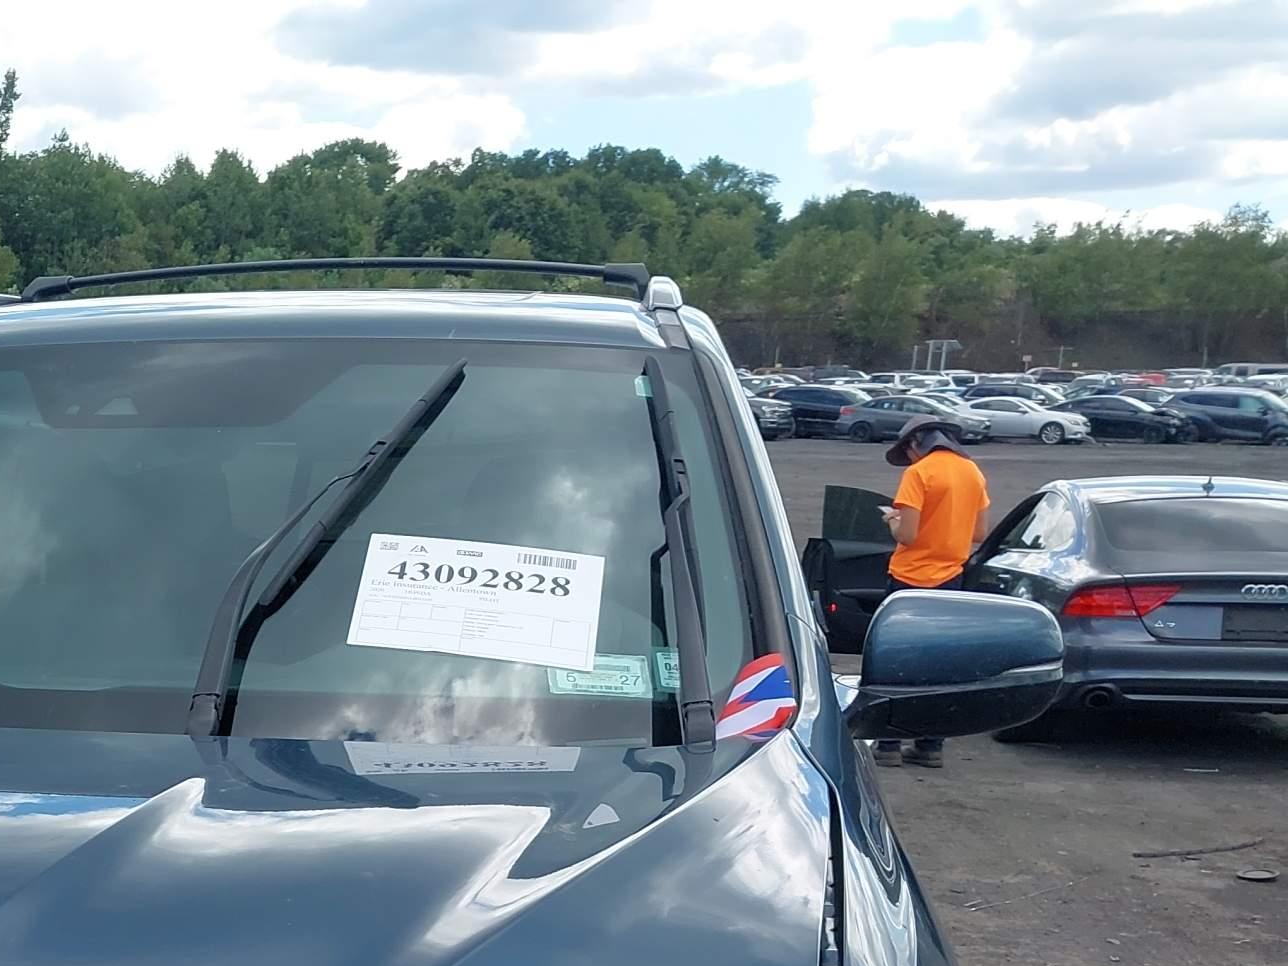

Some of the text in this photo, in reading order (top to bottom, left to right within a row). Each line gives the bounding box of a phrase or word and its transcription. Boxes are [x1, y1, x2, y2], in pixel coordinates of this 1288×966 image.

[371, 579, 391, 587] Erie
[393, 581, 439, 591] Insurance
[447, 585, 497, 596] Allentown
[387, 560, 571, 597] 43092828
